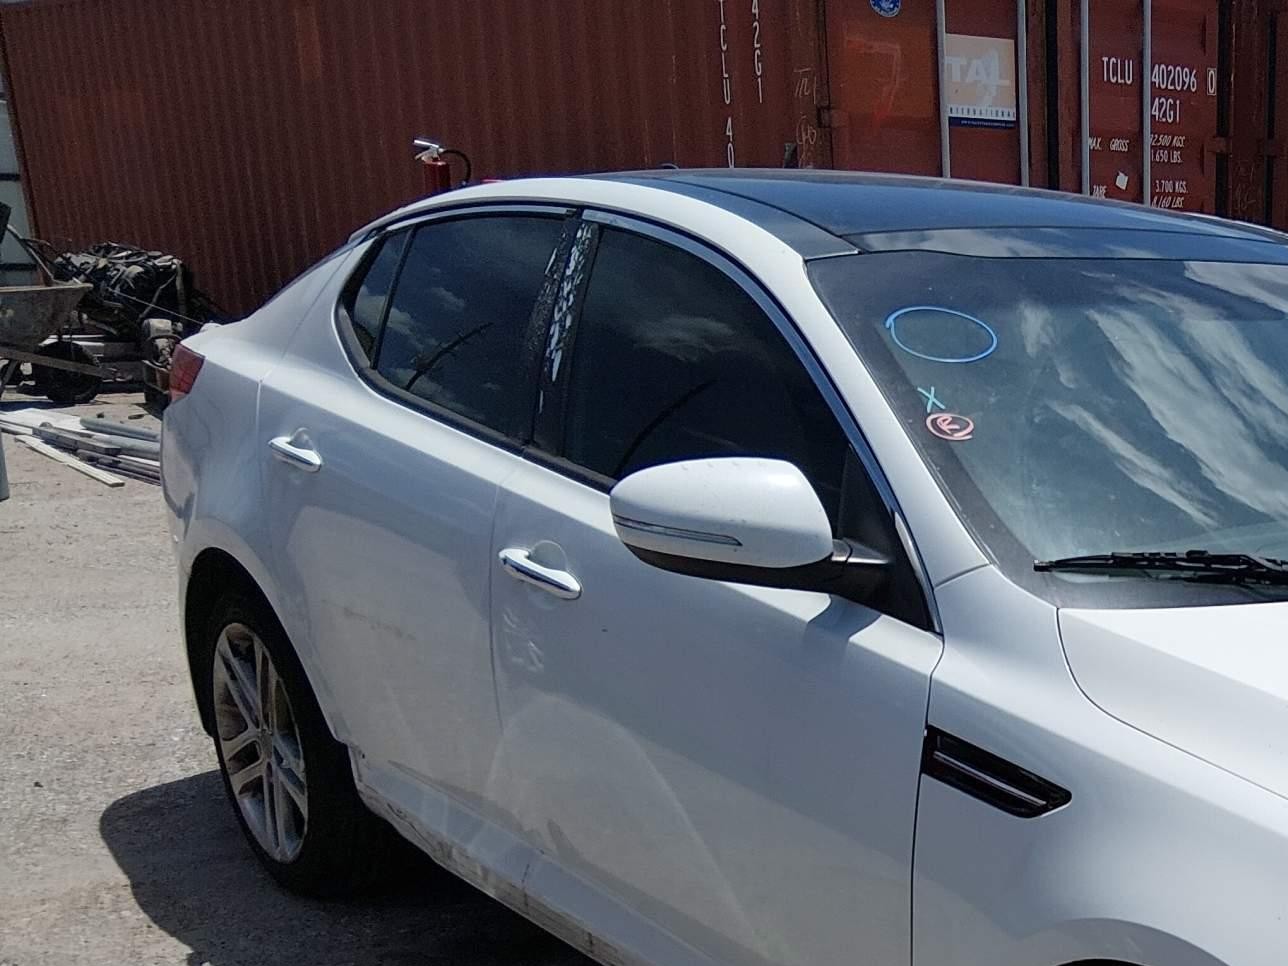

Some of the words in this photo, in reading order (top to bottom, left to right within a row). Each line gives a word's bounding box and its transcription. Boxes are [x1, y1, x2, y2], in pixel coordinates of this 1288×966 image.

[714, 0, 731, 105] TCLU
[751, 0, 763, 104] 42G1
[1102, 56, 1133, 85] TCLU
[1151, 63, 1197, 93] 402096
[1208, 70, 1216, 94] 0
[1151, 97, 1181, 123] 42G1
